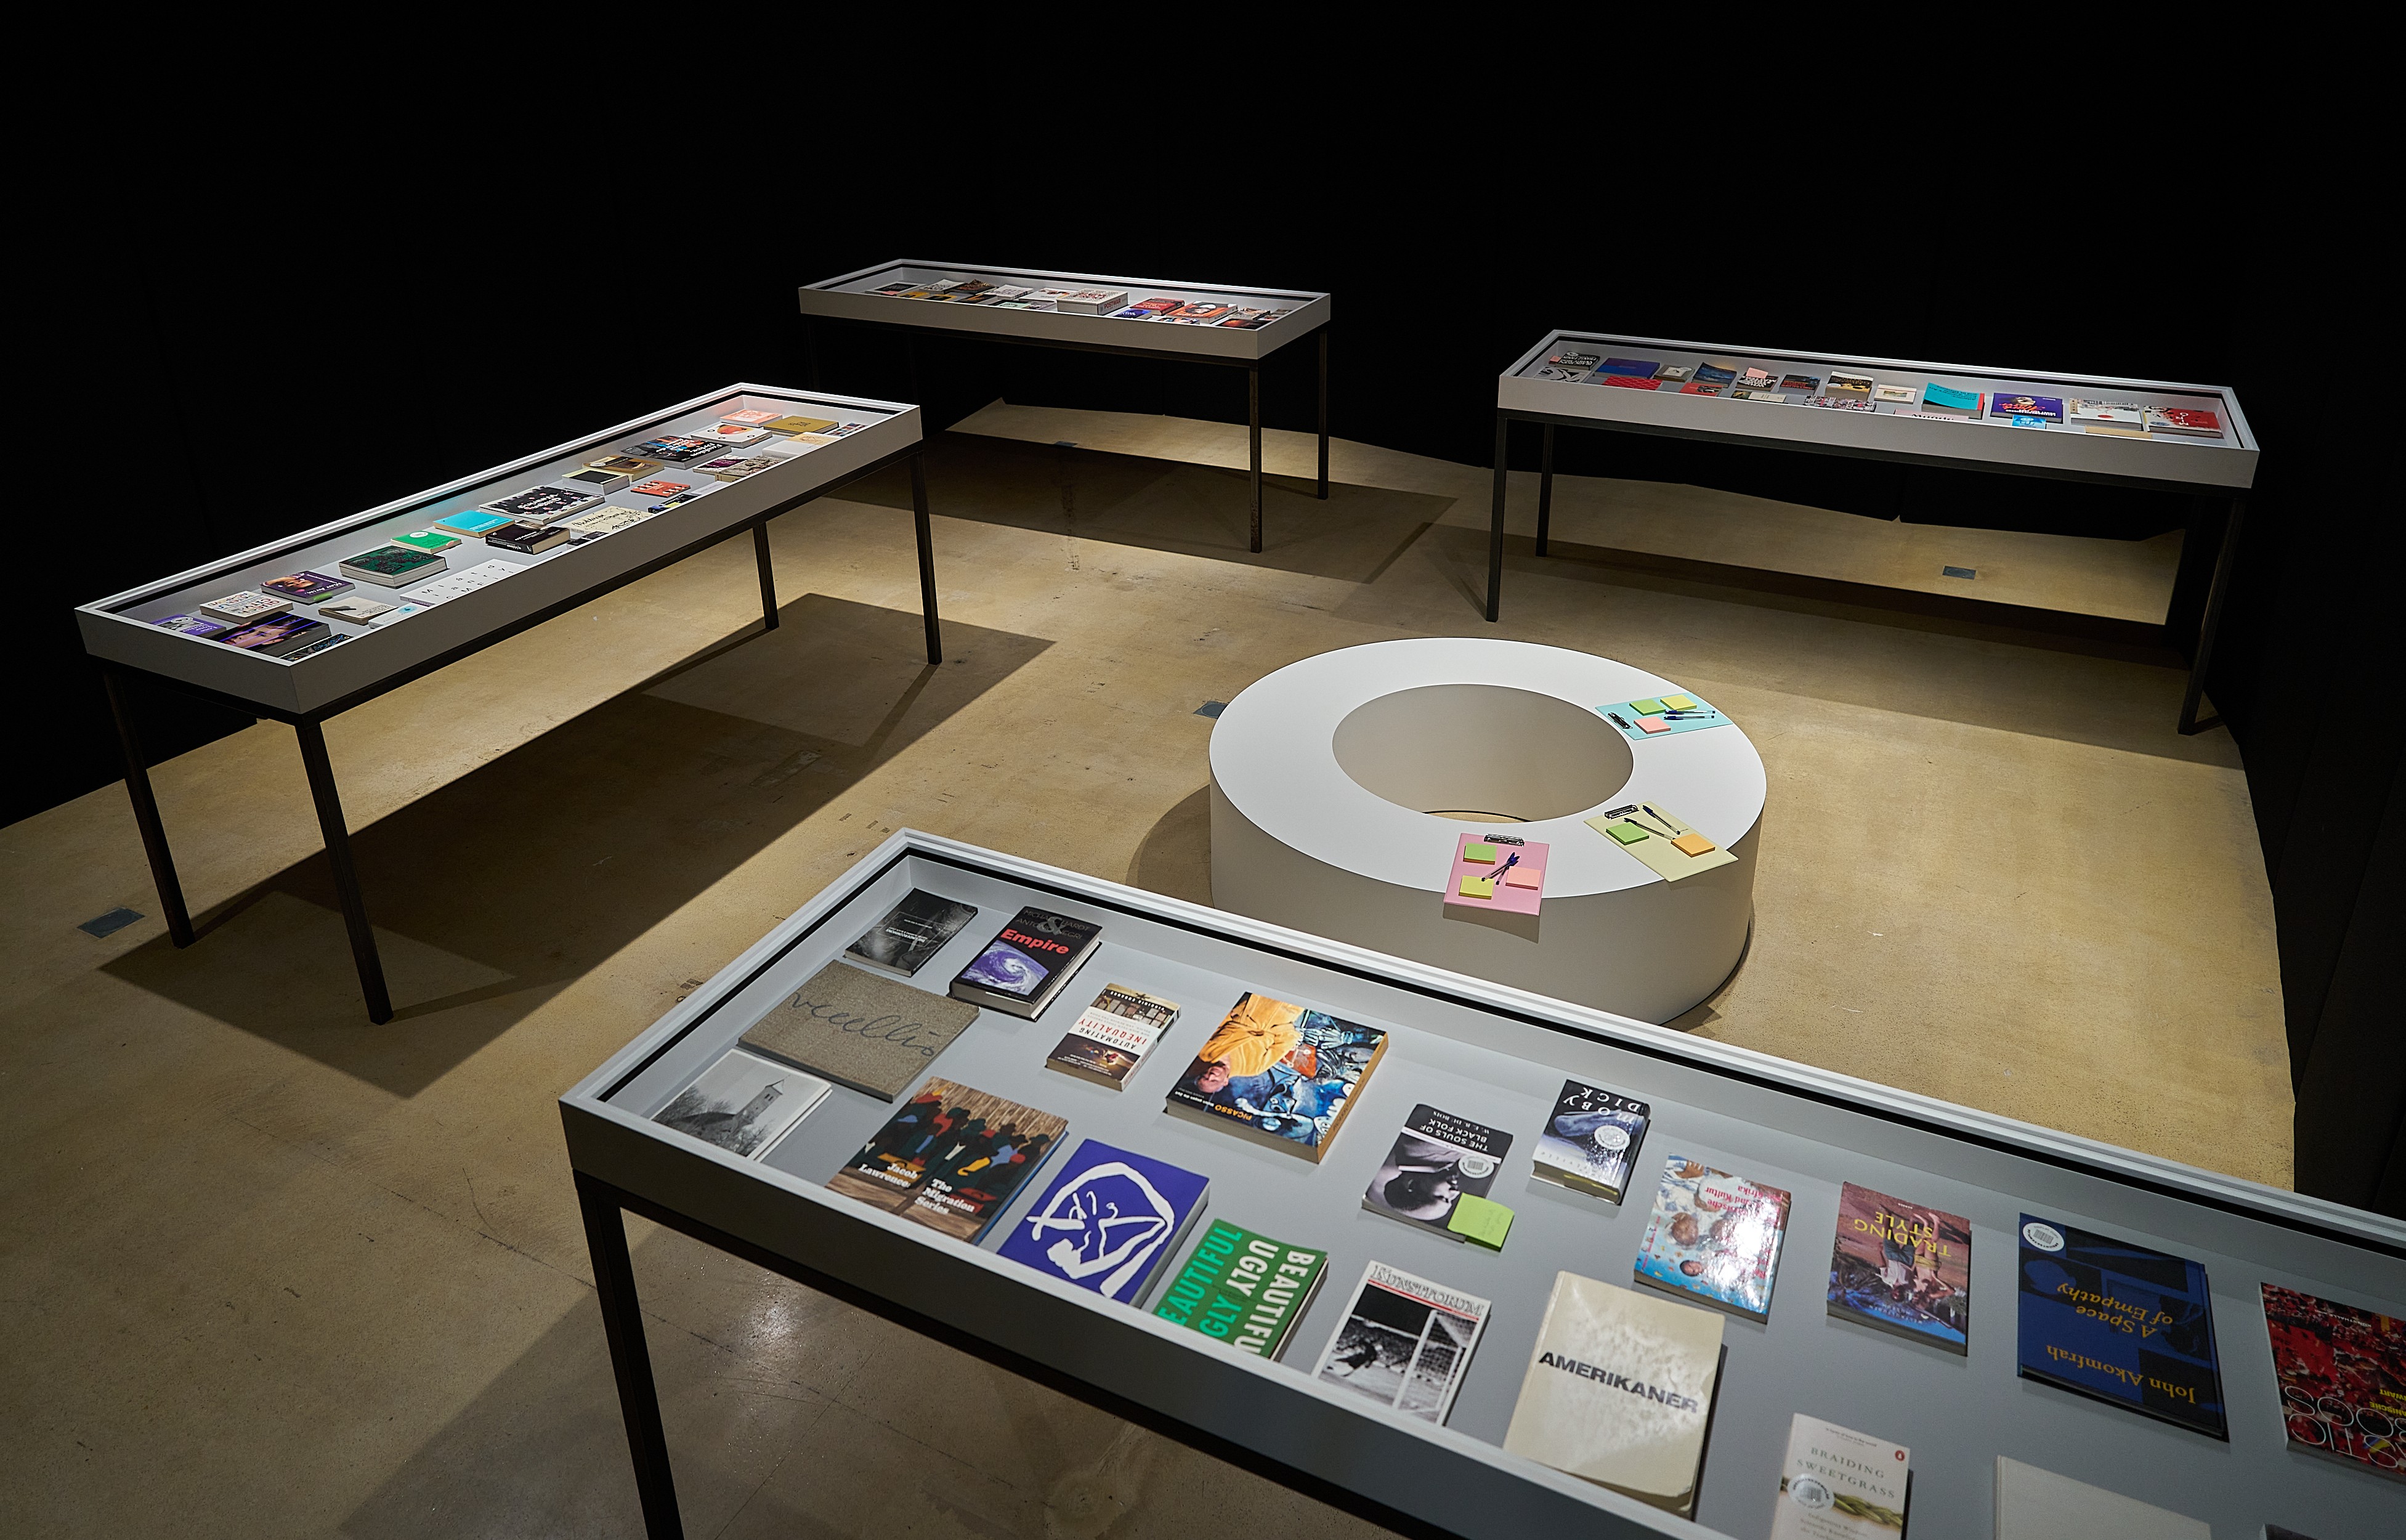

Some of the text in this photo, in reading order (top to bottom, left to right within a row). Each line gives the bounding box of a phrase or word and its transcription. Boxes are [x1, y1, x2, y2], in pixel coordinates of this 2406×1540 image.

[1104, 299, 1122, 309] POSTWAR
[1000, 928, 1070, 955] Empire
[1079, 1018, 1148, 1045] INEQUALITY
[1079, 1027, 1136, 1050] AUTOMATING
[1214, 1104, 1252, 1121] PICASSO
[1580, 1087, 1641, 1112] DICK
[1432, 1110, 1450, 1121] BOIS
[1419, 1124, 1489, 1152] THE SOULS OF
[1428, 1117, 1488, 1144] BLACK FOLK
[858, 1163, 912, 1189] Lawrence:
[887, 1162, 918, 1180] Jacob
[932, 1178, 953, 1193] The
[1704, 1186, 1733, 1202] Kultur
[914, 1196, 950, 1215] Series
[922, 1187, 975, 1214] Migration
[1853, 1218, 1952, 1258] TRADING
[1874, 1211, 1934, 1239] STYLE
[1157, 1226, 1243, 1326] EAUTIFUL
[1225, 1239, 1280, 1298] UGLY
[1233, 1250, 1317, 1355] BEAUTIFU
[1370, 1265, 1485, 1318] KUNSTFORUM
[2056, 1282, 2174, 1326] of Empathy
[1198, 1293, 1242, 1338] GLY
[2076, 1305, 2159, 1339] A Space
[1539, 1352, 1699, 1414] AMERIKANER
[2046, 1344, 2197, 1405] John Akomfrah
[1810, 1447, 1885, 1479] BRAIDING
[1796, 1458, 1897, 1499] SWEETGRASS
